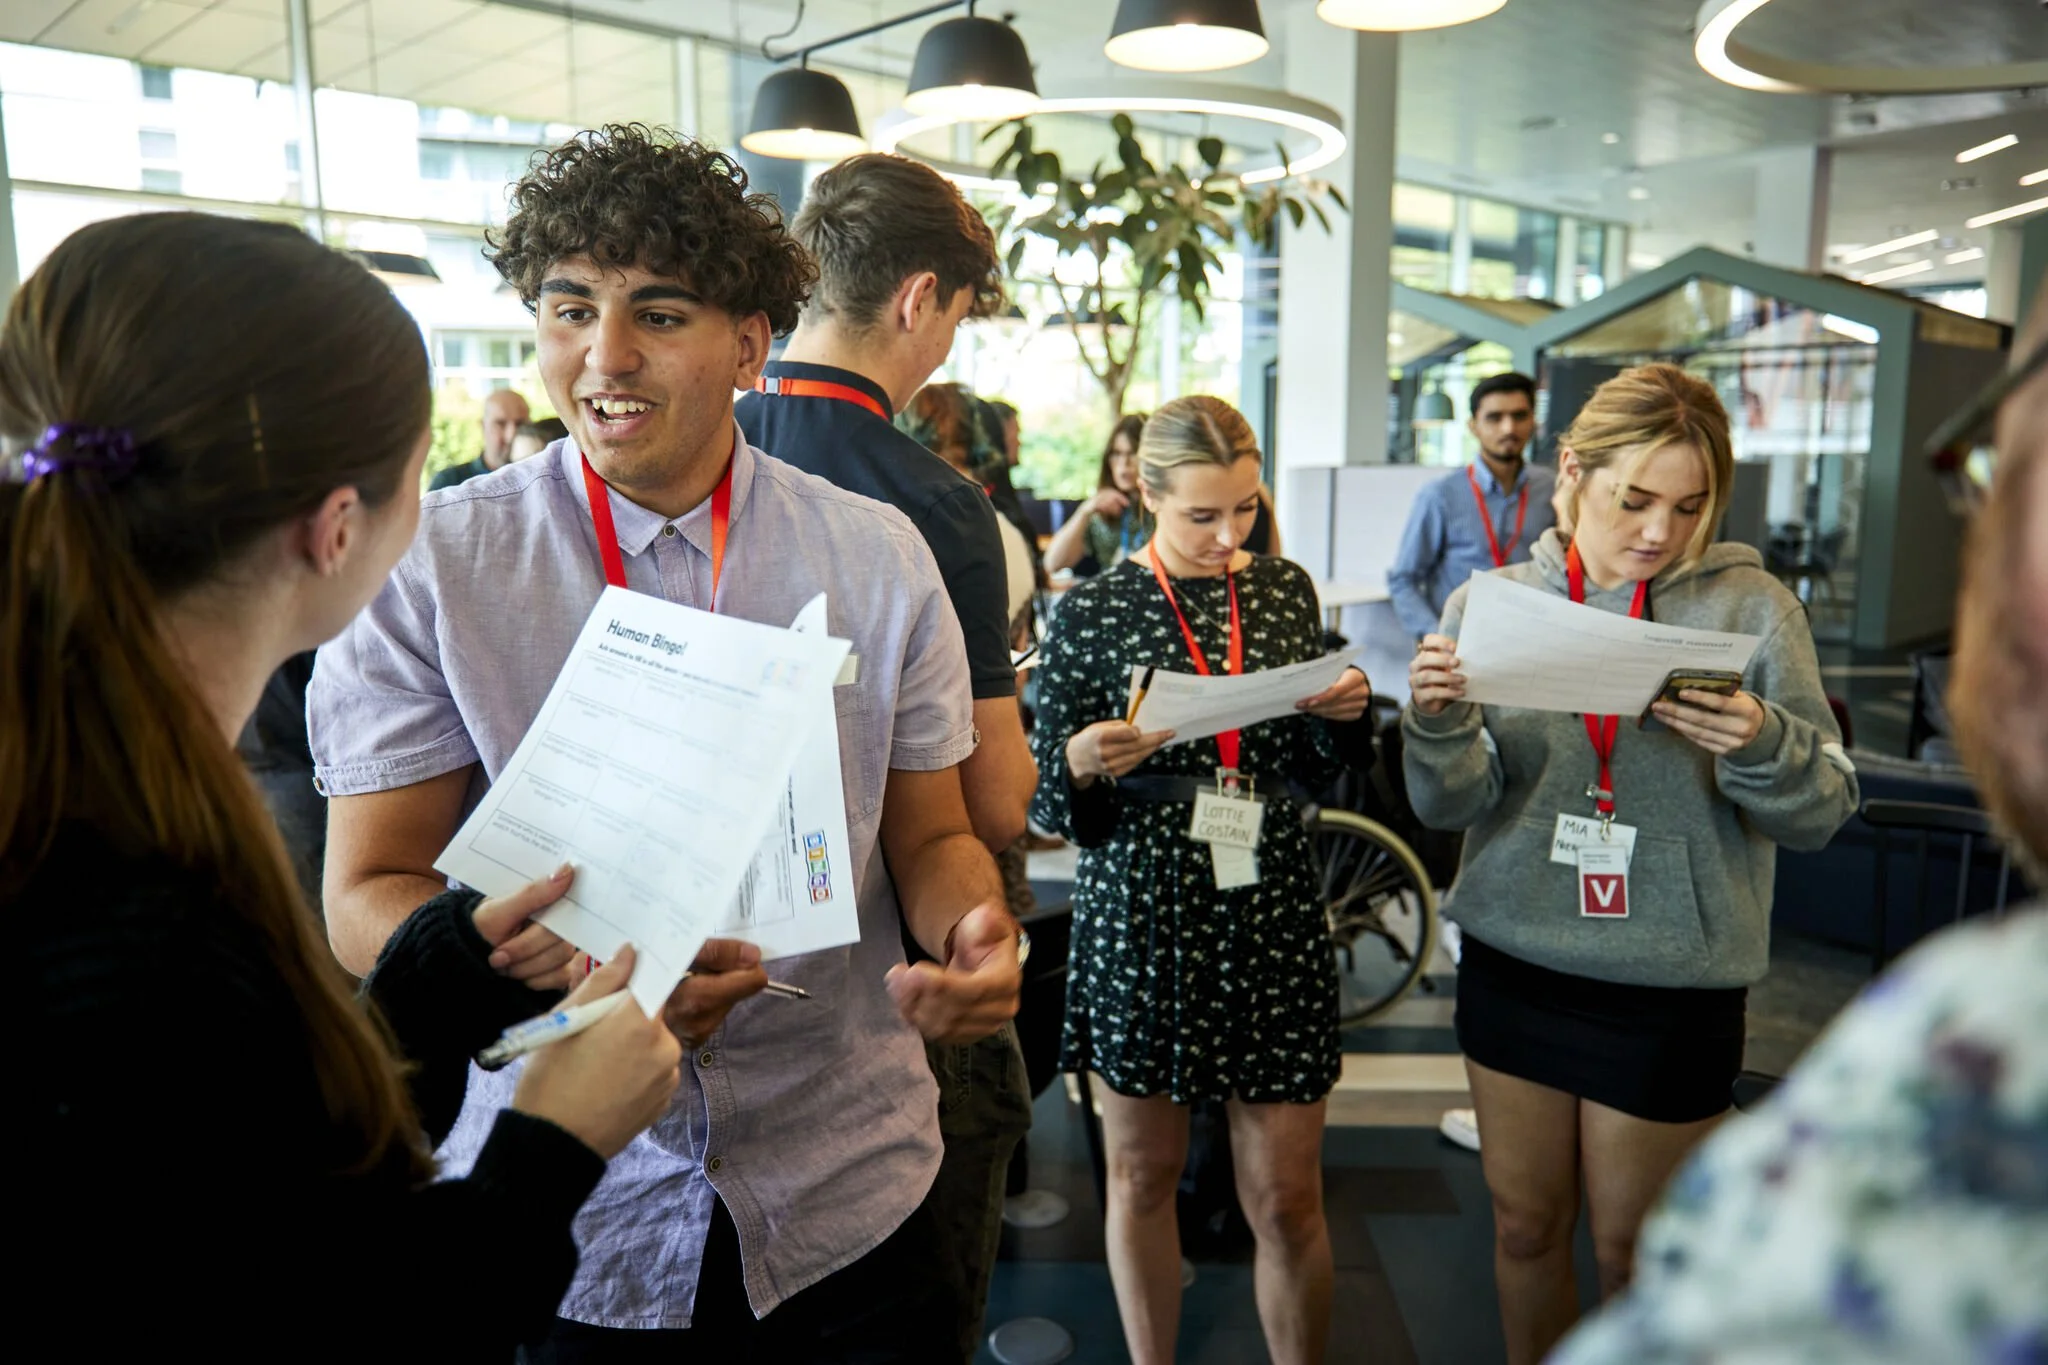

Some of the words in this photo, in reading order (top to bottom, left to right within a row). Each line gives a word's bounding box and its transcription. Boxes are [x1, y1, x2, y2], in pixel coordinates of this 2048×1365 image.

[606, 618, 650, 645] Human
[651, 632, 688, 656] Bingo!
[1203, 801, 1246, 823] LOTTIE
[1198, 821, 1252, 843] COSTAIN
[1563, 820, 1588, 838] MIA
[1590, 879, 1618, 908] V
